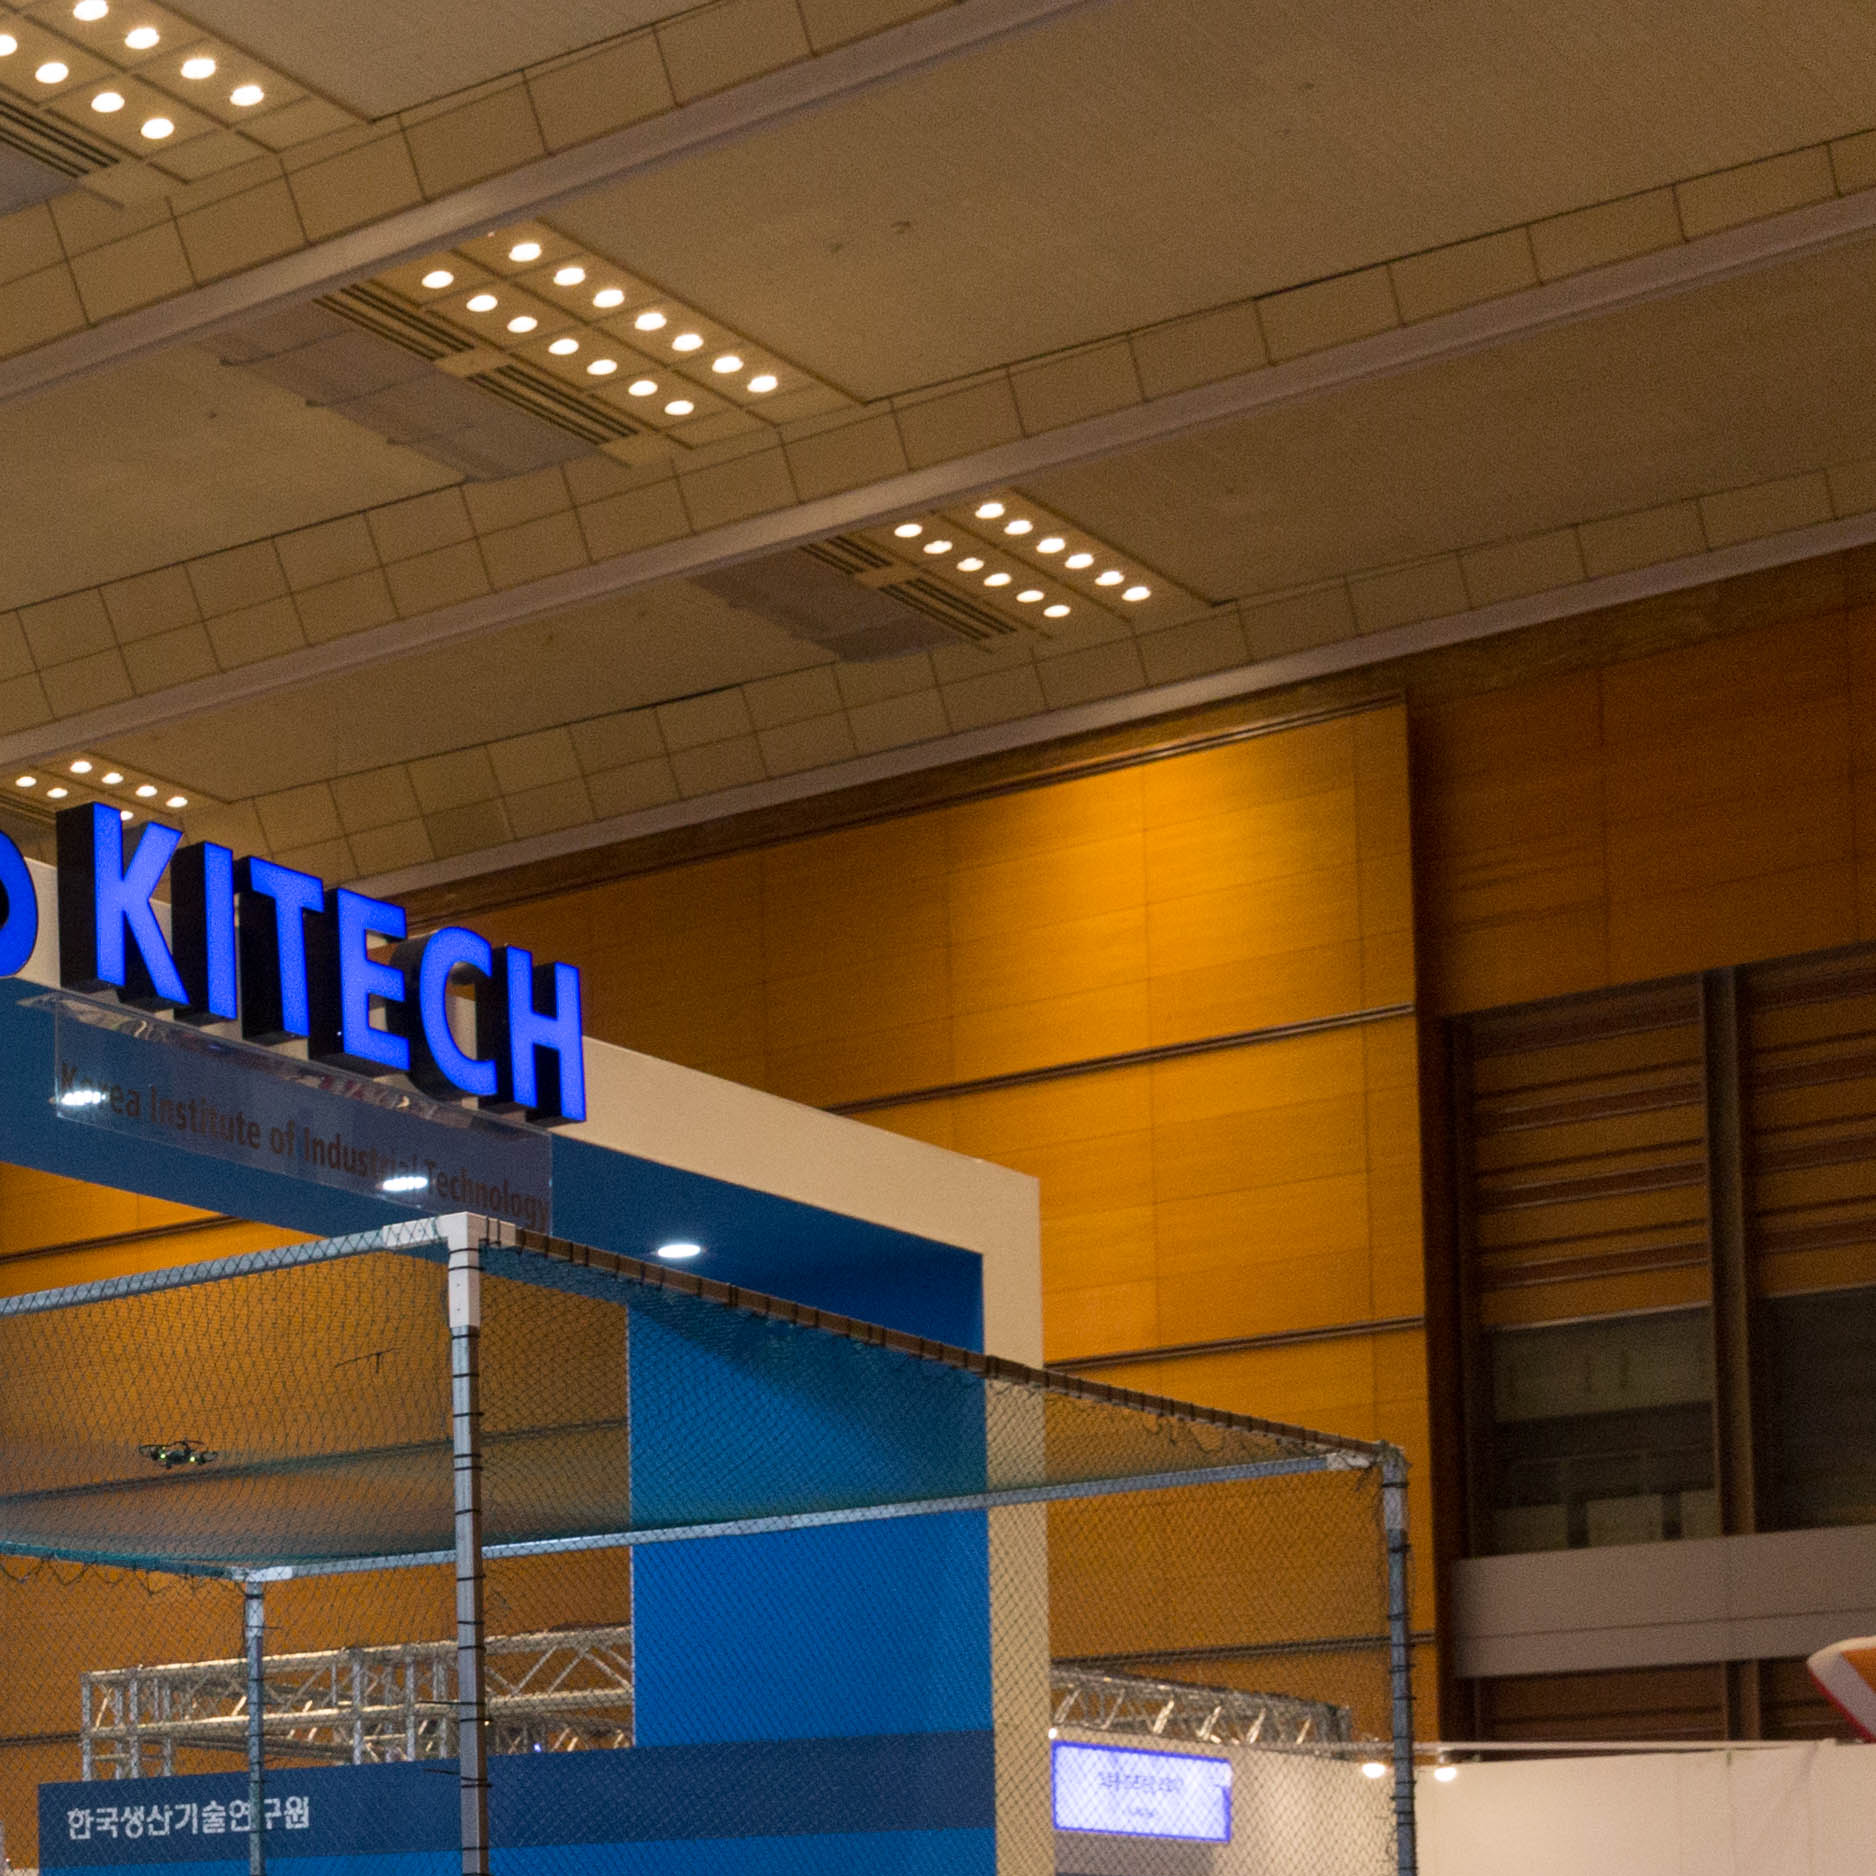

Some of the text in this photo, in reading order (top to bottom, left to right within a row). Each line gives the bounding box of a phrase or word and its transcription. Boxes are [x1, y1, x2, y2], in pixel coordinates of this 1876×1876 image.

[91, 803, 586, 1122] KITECH
[59, 1061, 142, 1119] Kea
[150, 1086, 262, 1151] Institute
[269, 1121, 296, 1155] of
